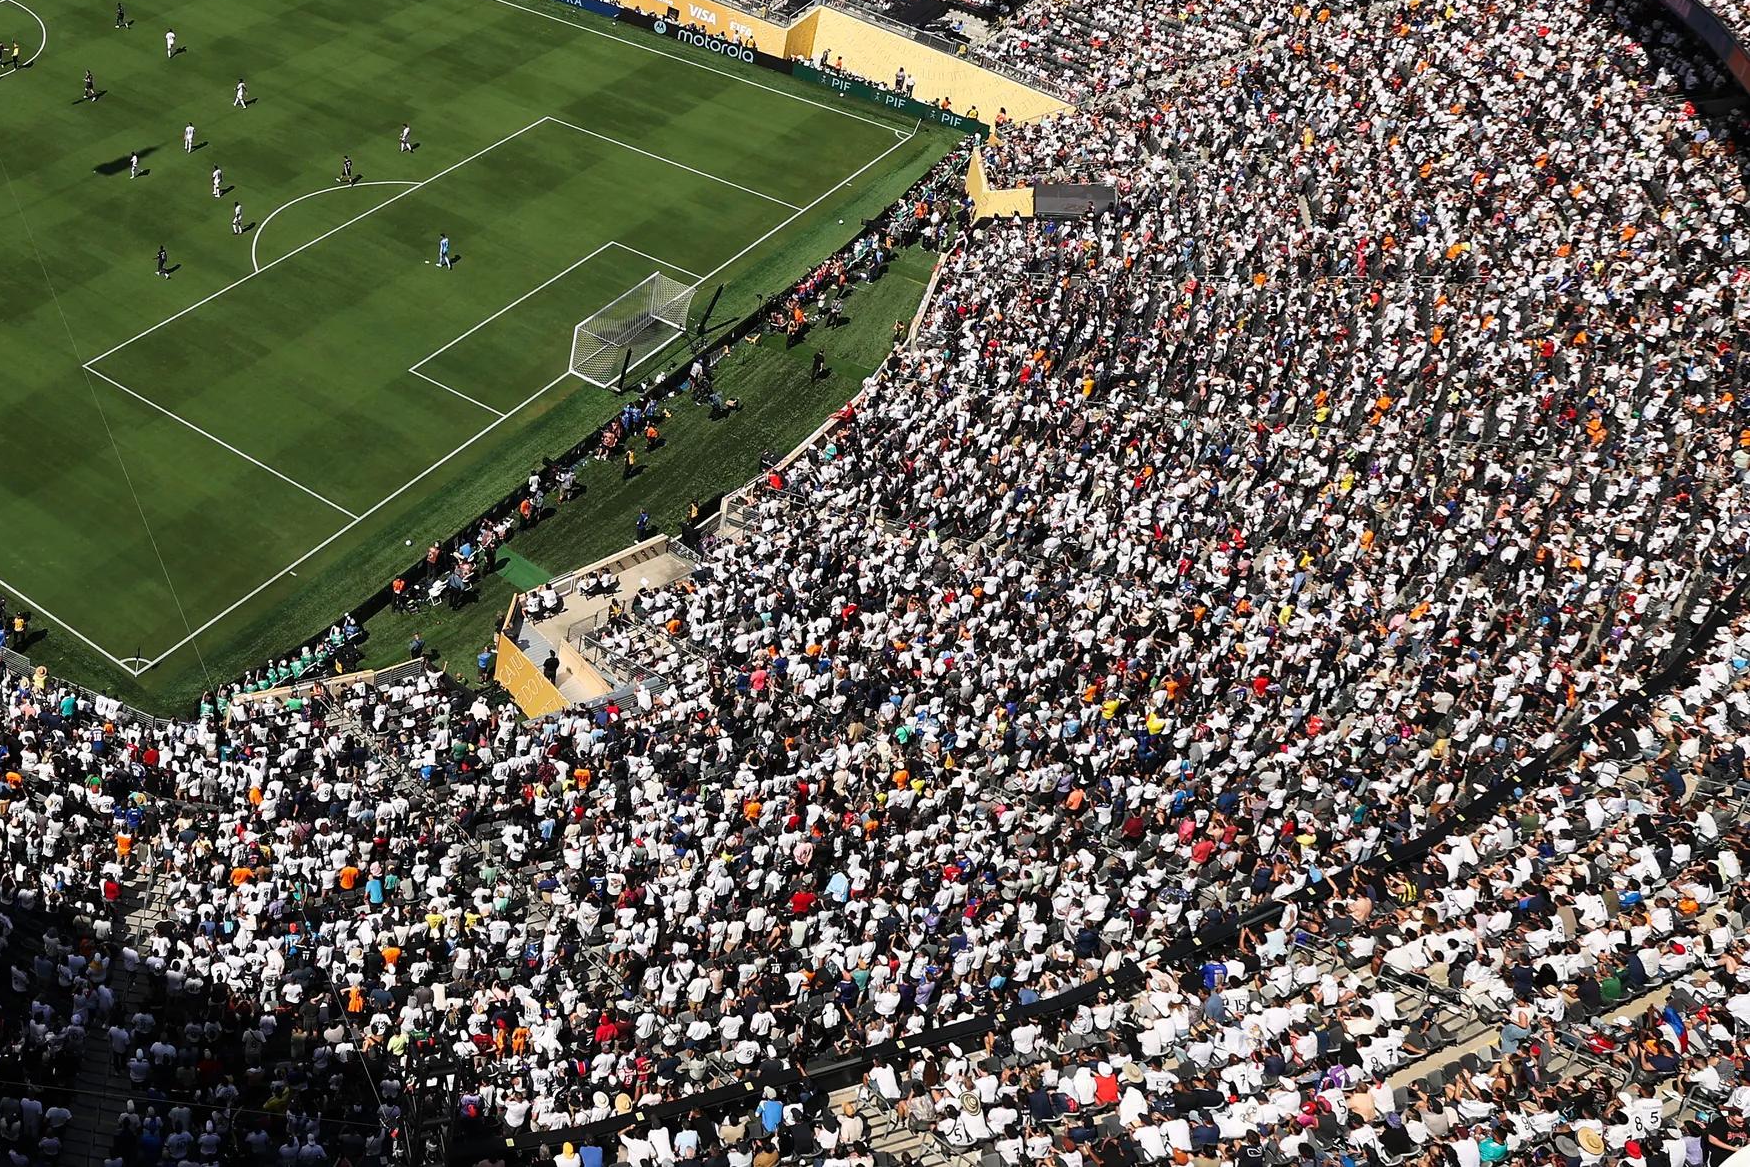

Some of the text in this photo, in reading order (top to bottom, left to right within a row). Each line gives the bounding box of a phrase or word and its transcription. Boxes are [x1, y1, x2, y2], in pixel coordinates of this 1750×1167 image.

[688, 2, 718, 26] VISA
[729, 20, 753, 37] FIFA
[677, 28, 754, 64] motorola
[831, 76, 852, 92] PIF
[885, 93, 907, 109] PIF
[941, 112, 963, 128] PIF
[1234, 998, 1246, 1012] 15
[1386, 1048, 1394, 1061] 7
[1371, 1056, 1380, 1070] 9
[1336, 1099, 1347, 1115] 5
[1522, 1116, 1531, 1130] 9
[1634, 1115, 1643, 1132] 8
[1650, 1111, 1659, 1125] 5
[954, 1127, 963, 1141] 5
